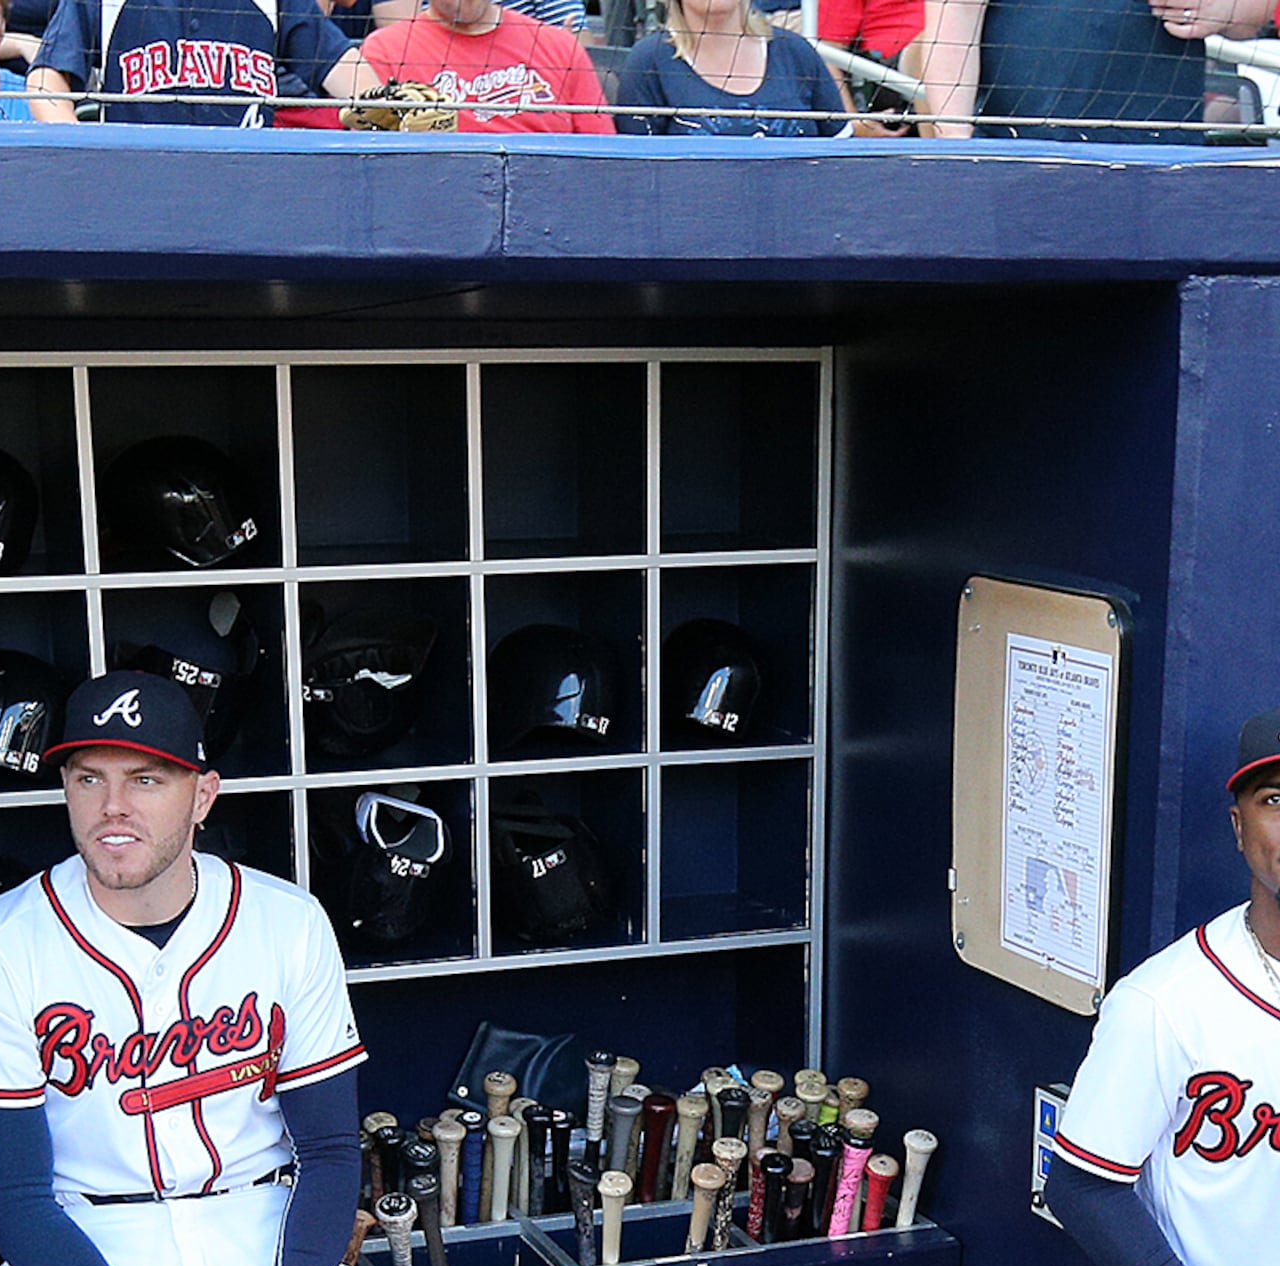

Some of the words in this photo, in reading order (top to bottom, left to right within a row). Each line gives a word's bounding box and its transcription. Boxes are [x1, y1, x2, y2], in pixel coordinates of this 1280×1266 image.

[120, 40, 277, 97] BRAVES
[175, 661, 199, 685] 25
[93, 688, 142, 728] A
[721, 711, 739, 732] 12
[22, 751, 40, 772] 16
[391, 854, 411, 877] 24
[33, 991, 263, 1097] Braves
